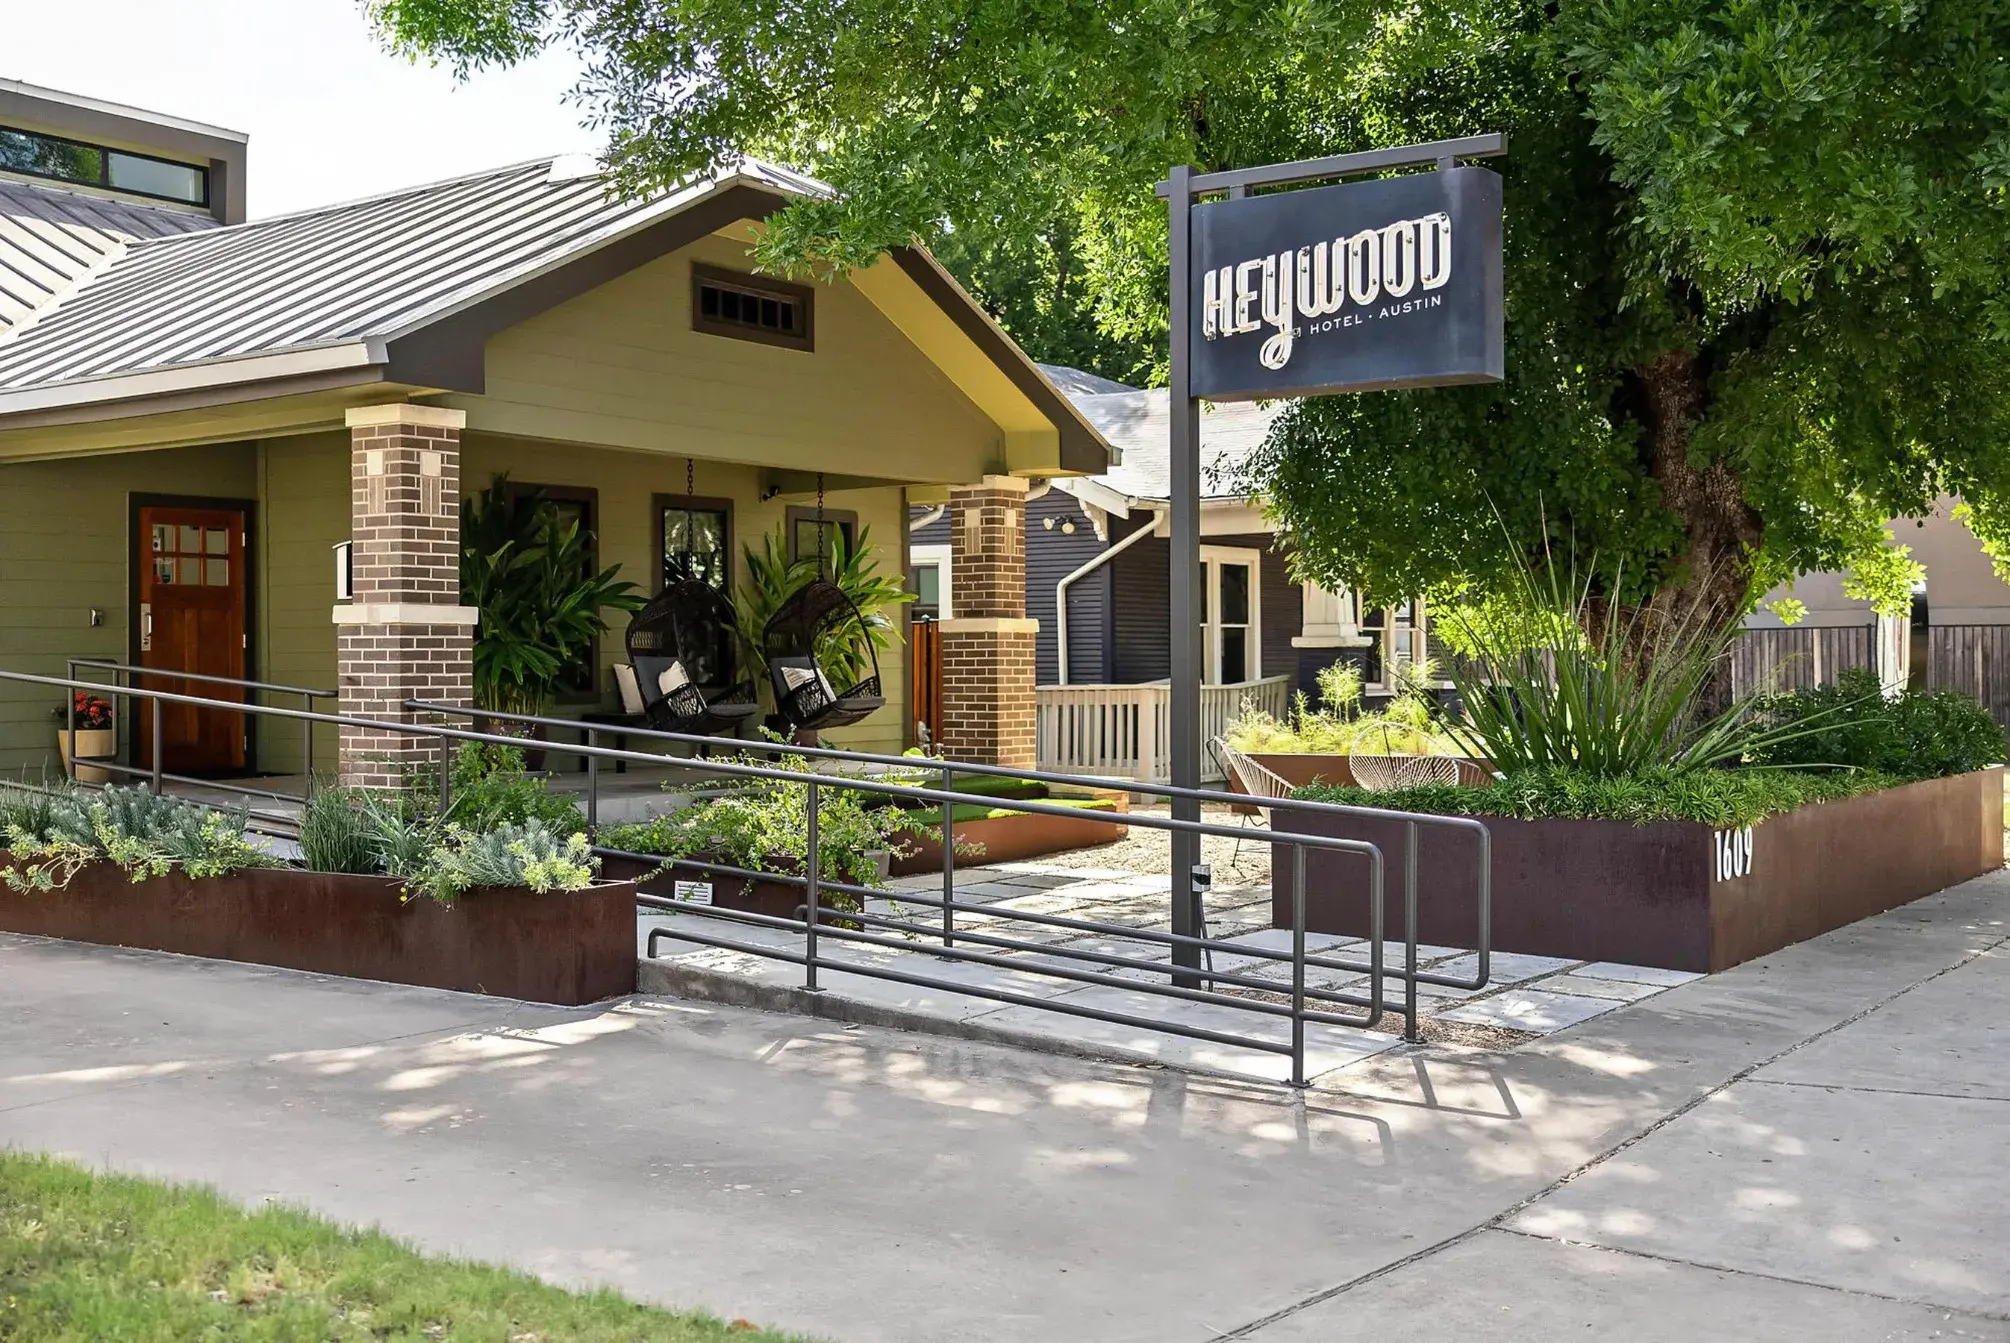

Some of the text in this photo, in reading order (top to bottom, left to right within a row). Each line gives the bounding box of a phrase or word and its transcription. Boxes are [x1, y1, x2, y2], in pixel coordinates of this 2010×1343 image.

[1309, 294, 1441, 335] HOTEL AUSTIN
[1714, 824, 1753, 883] 1609
